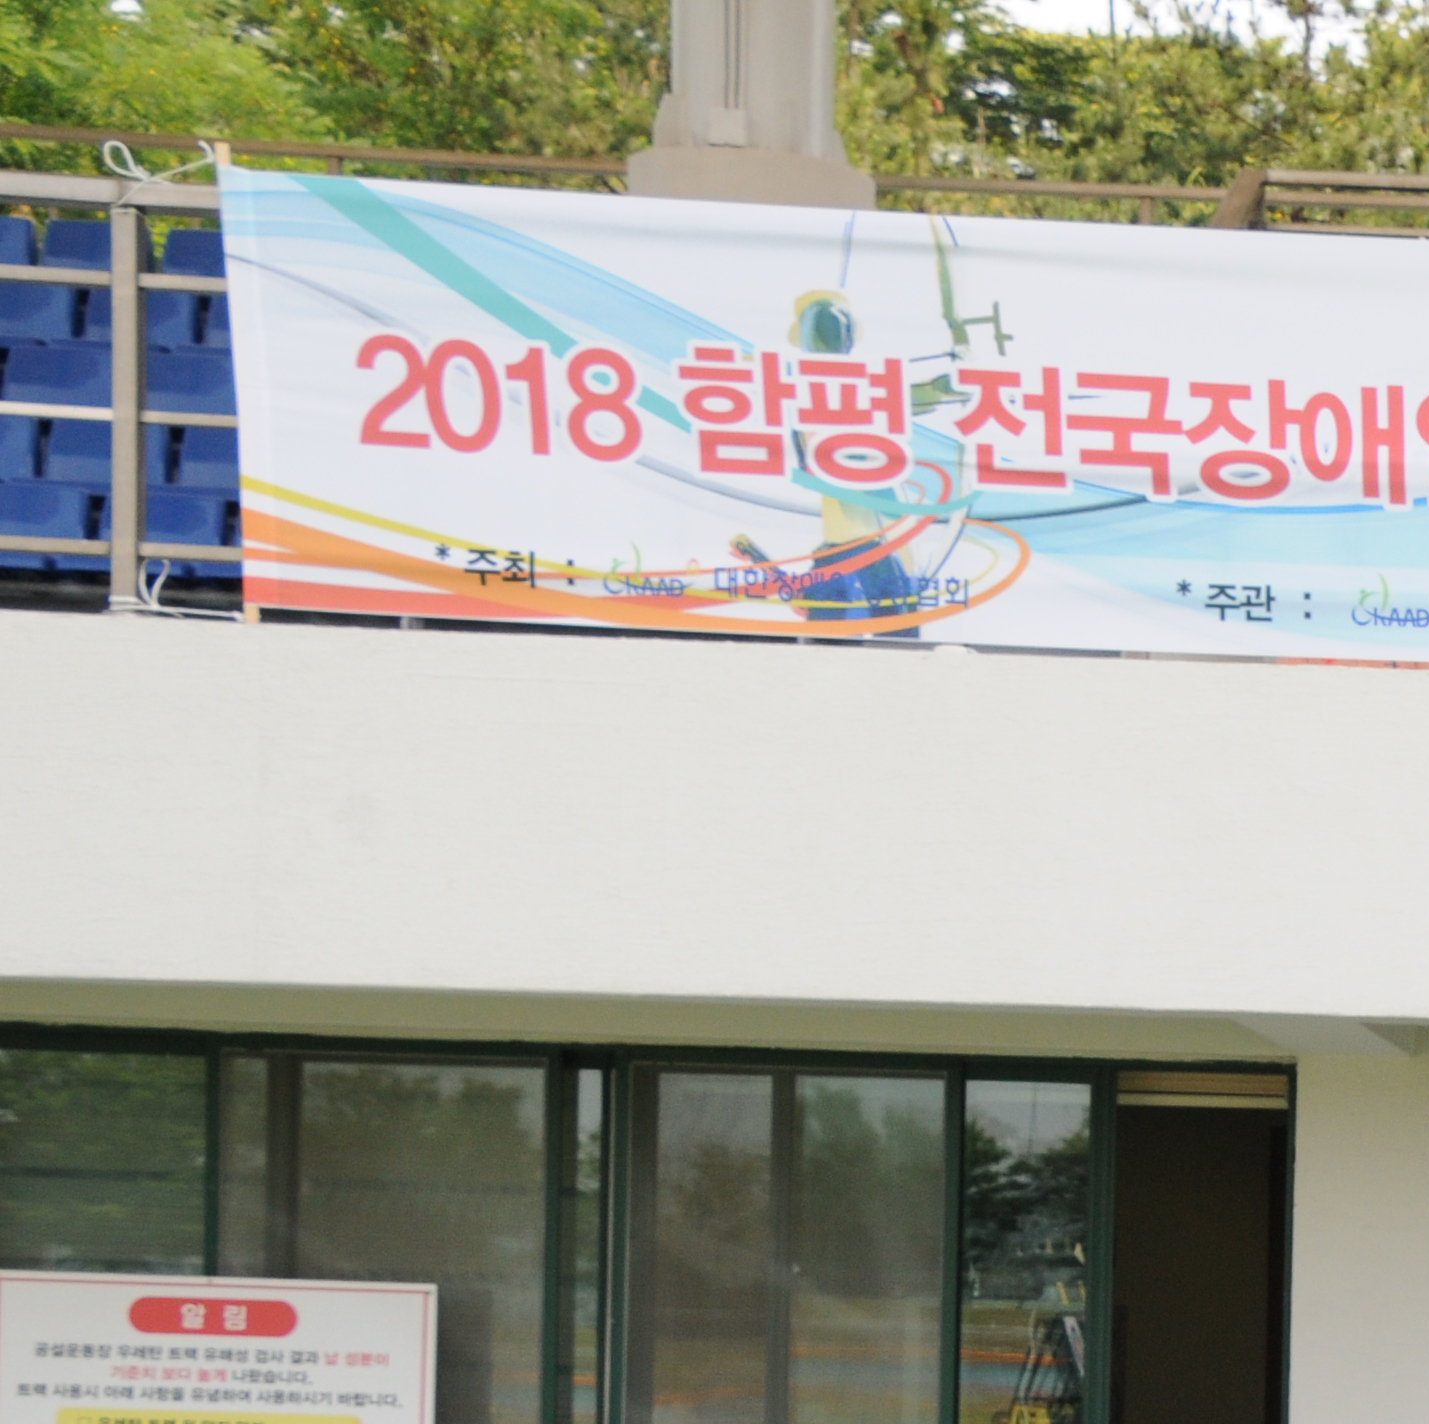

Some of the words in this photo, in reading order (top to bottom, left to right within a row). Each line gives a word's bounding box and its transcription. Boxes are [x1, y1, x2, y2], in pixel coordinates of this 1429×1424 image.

[356, 334, 642, 463] 2018
[678, 346, 909, 484] 함평
[463, 549, 536, 589] 주최
[1204, 583, 1276, 623] 주관
